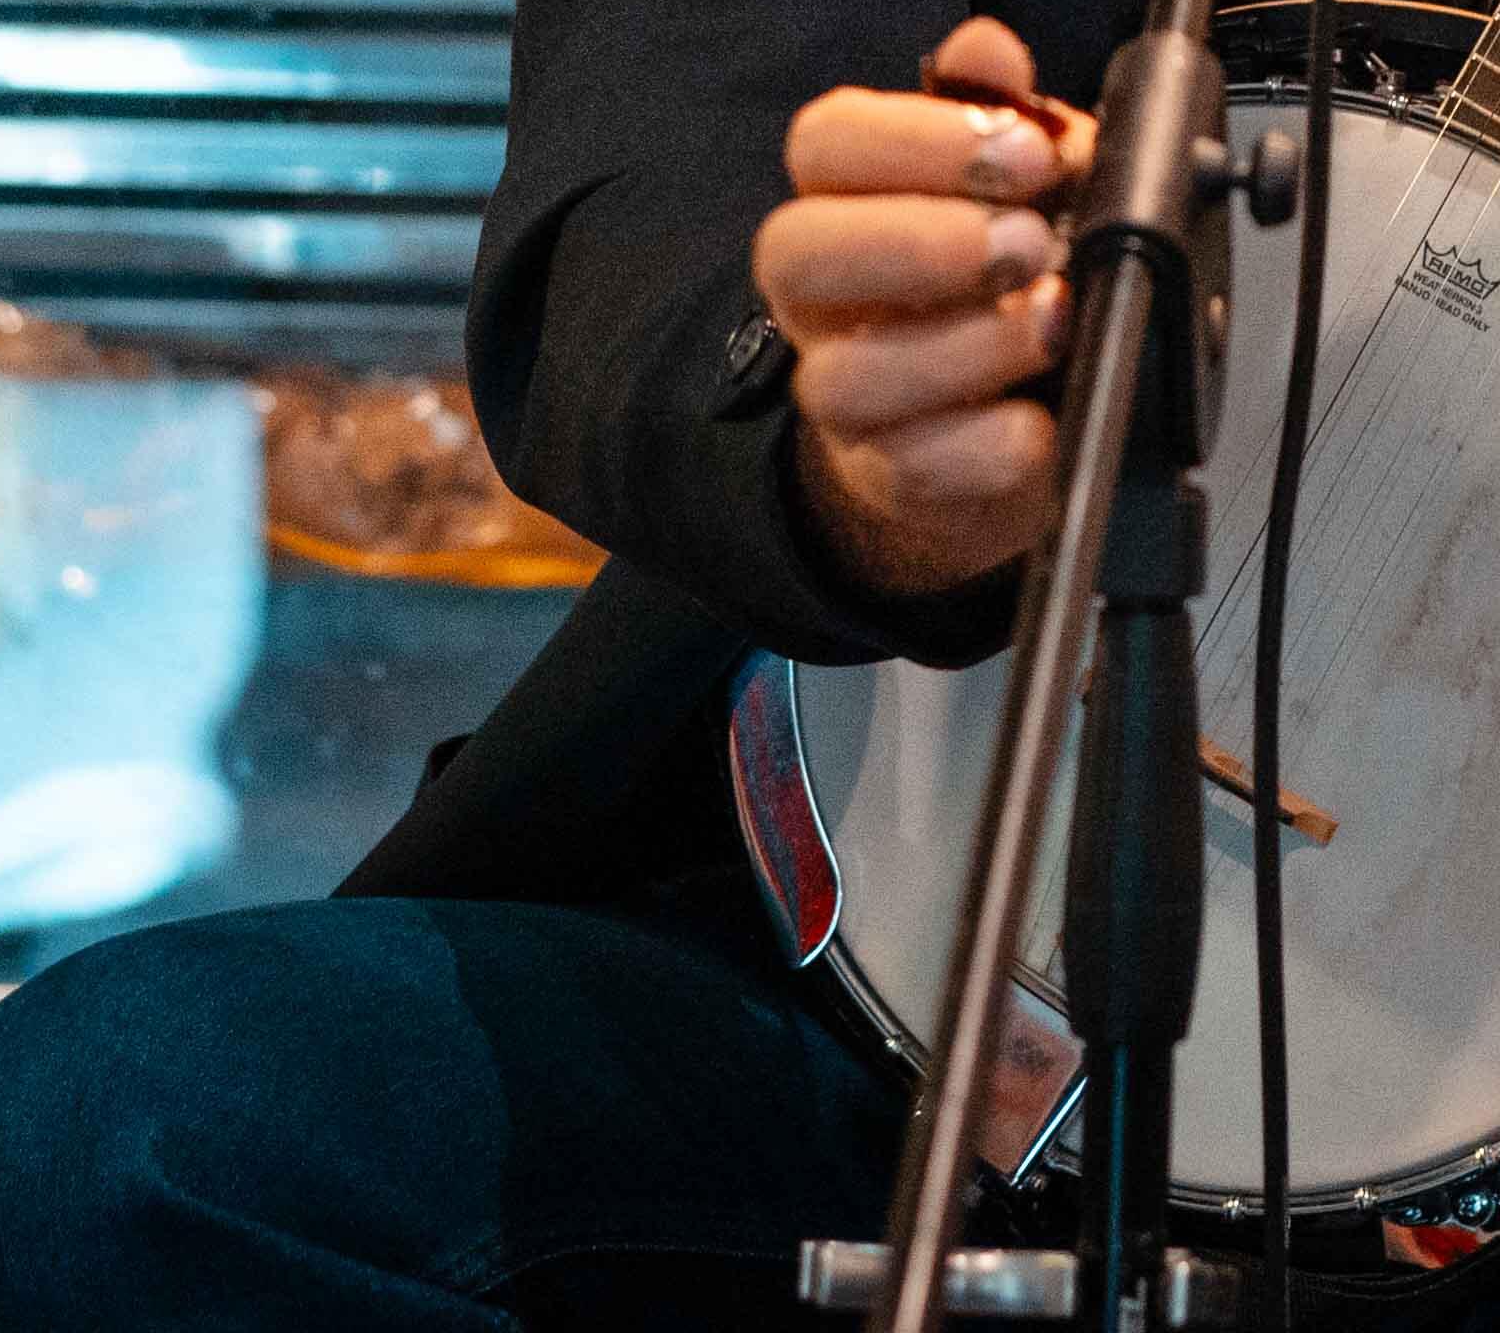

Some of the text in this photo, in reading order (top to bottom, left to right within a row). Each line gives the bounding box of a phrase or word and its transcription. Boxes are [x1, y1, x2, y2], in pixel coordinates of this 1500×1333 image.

[1428, 256, 1485, 294] REMO
[1394, 275, 1430, 301] BANJO
[1461, 312, 1492, 333] ONLY
